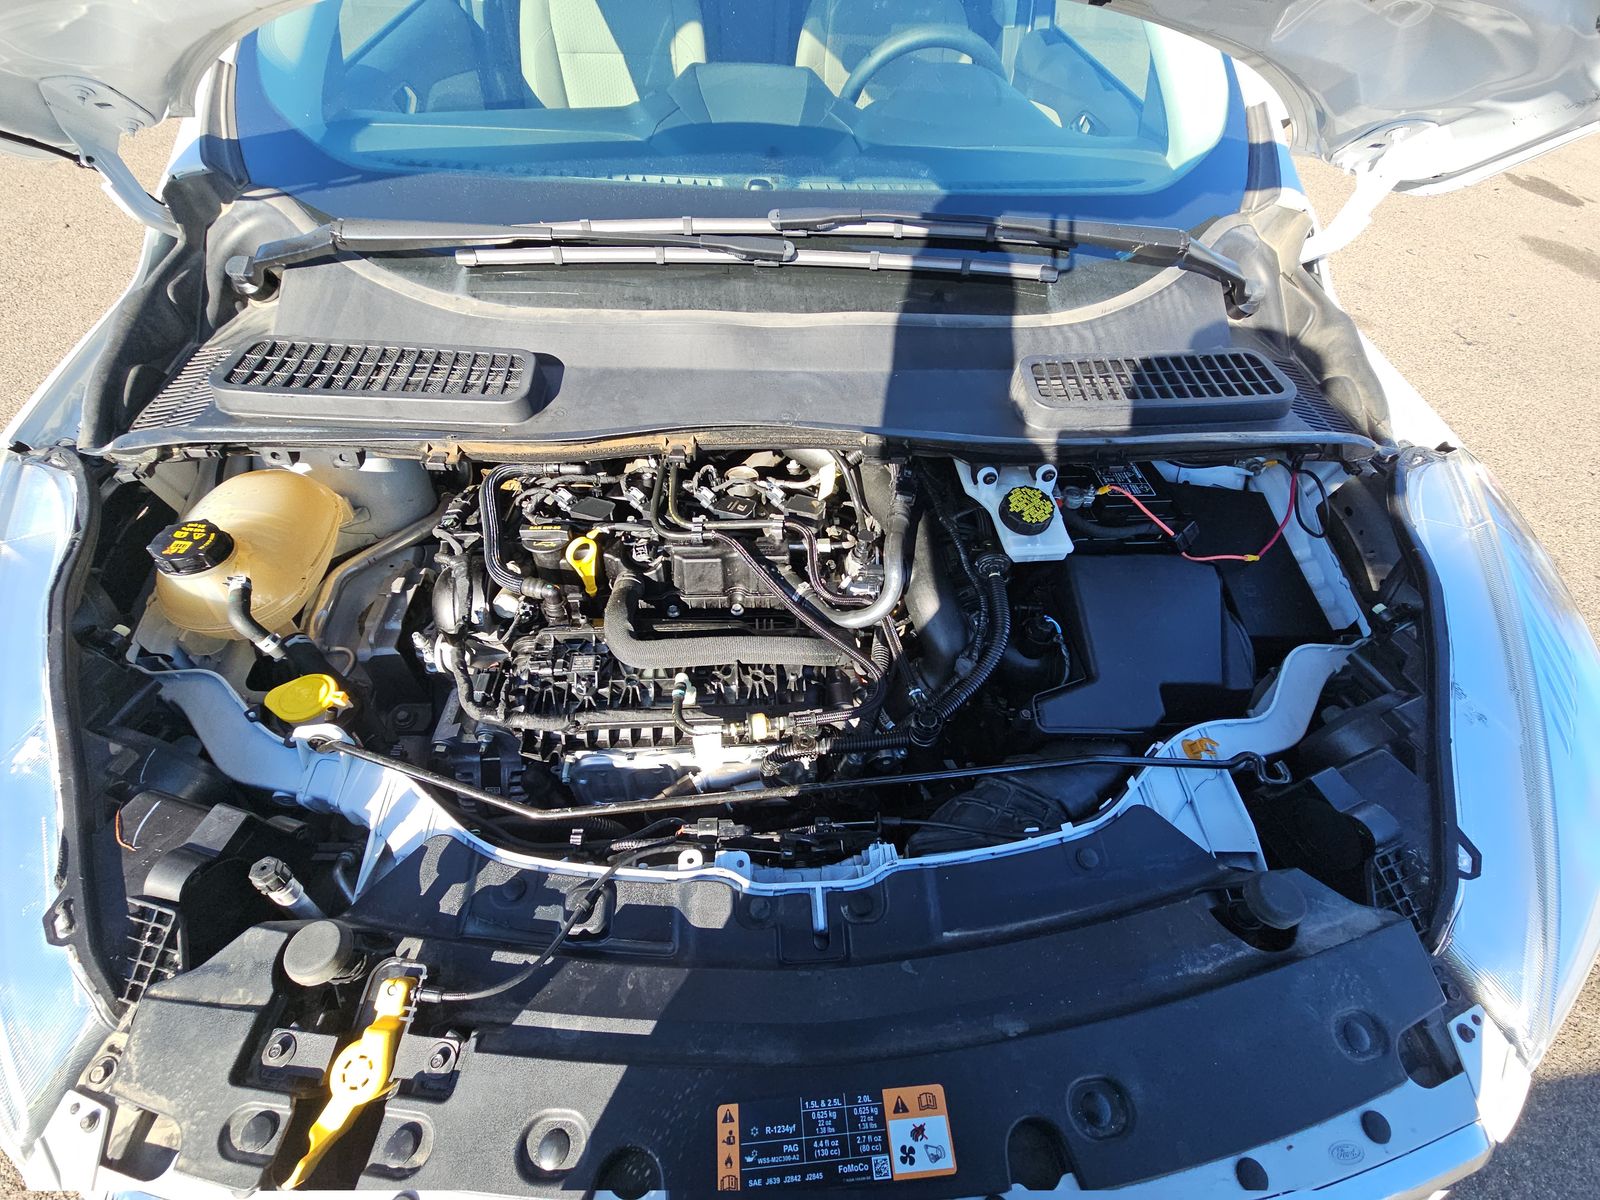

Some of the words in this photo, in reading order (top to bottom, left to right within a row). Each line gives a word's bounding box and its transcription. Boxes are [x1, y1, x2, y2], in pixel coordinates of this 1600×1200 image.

[857, 1095, 872, 1103] 2.0L
[812, 1111, 828, 1119] 0.625
[829, 1110, 836, 1119] kg
[854, 1107, 869, 1115] 0.625
[870, 1106, 878, 1115] kg
[765, 1124, 796, 1134] R-1234yf
[783, 1144, 799, 1153] PAG
[871, 1143, 882, 1152] cc)
[814, 1148, 828, 1158] (130
[830, 1148, 840, 1156] cc)
[838, 1163, 869, 1173] FoMoCo
[749, 1179, 762, 1187] SAE
[784, 1175, 801, 1183] J2842
